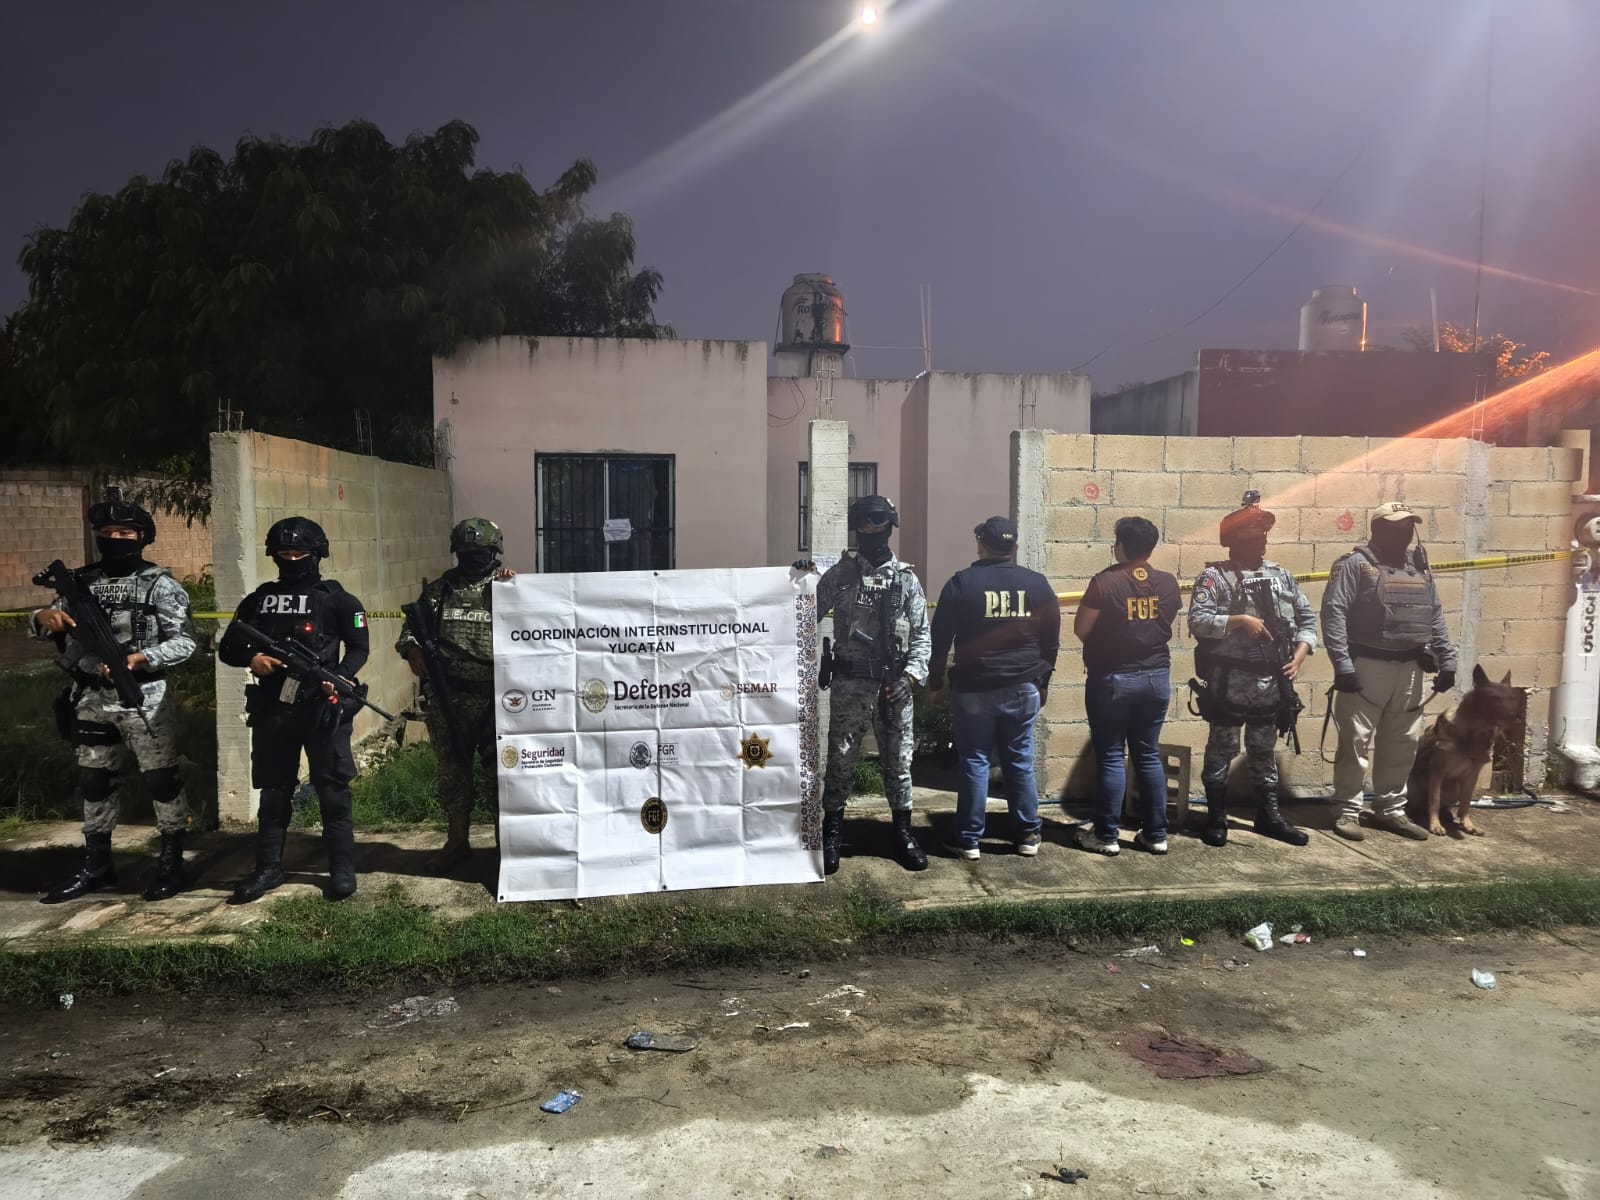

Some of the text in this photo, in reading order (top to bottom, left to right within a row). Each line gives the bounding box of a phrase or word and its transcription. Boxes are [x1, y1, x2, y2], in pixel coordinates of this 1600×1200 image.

[93, 585, 128, 595] GUARDIA
[260, 594, 312, 613] P.E.I.
[984, 590, 1031, 617] P.E.I.
[1127, 596, 1159, 620] FGE
[511, 622, 769, 641] COORDINACIÓN INTERINSTITUCIONAL
[609, 639, 675, 653] YUCATÁN
[532, 689, 557, 701] GN
[613, 679, 691, 701] Defensa
[736, 683, 778, 694] SEMAR
[521, 747, 565, 761] Seguridad
[657, 744, 675, 755] FGR
